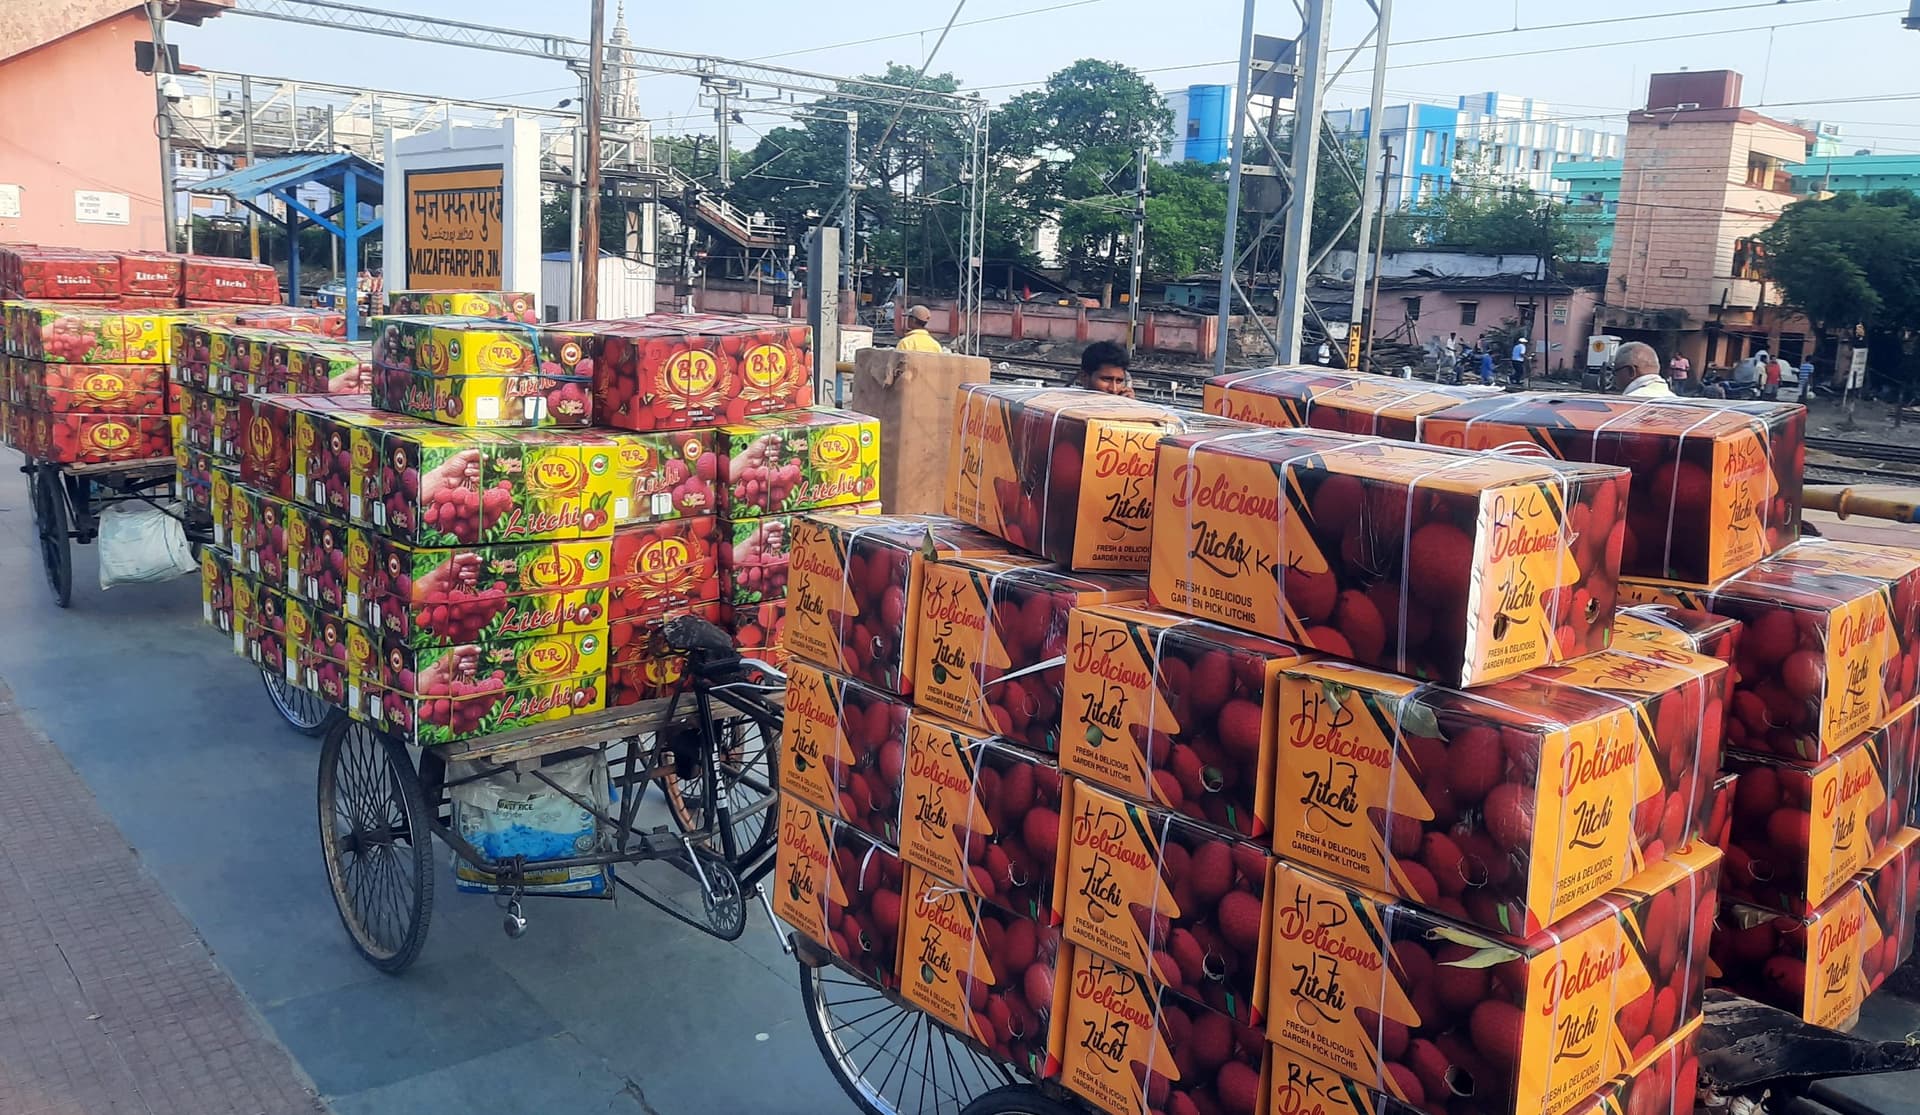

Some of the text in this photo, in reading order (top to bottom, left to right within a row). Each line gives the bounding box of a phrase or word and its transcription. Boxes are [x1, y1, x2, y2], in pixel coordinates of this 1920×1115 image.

[57, 274, 92, 285] Litchi
[136, 271, 169, 282] Litchi
[409, 247, 500, 277] MUZAFFARPUR JN.
[215, 278, 247, 288] Litchi
[492, 346, 518, 361] V.R.
[677, 359, 712, 381] B.R.
[751, 352, 782, 373] B.R.
[91, 379, 121, 393] B.R.
[99, 427, 127, 441] B.R.
[541, 463, 569, 478] V.R.
[634, 466, 680, 500] Litchi
[796, 472, 854, 505] Litchi
[1103, 493, 1152, 531] Litchi
[1172, 463, 1289, 522] Delicious
[503, 501, 580, 539] Litchi
[647, 547, 685, 570] B.R.
[792, 546, 843, 581] Delicious
[1188, 520, 1244, 578] Litchi
[1490, 525, 1559, 564] Delicious
[536, 562, 565, 576] V.R.
[796, 586, 824, 625] Litchi
[927, 592, 985, 631] Delicious
[1202, 585, 1208, 596] &
[1210, 587, 1253, 608] DELICIOUS
[1205, 600, 1223, 616] PICK
[1225, 606, 1256, 623] LITCHIS
[1493, 580, 1536, 625] Litchi
[497, 598, 576, 636] Litchi
[534, 649, 562, 661] V.R.
[931, 636, 965, 680] Litchi
[1073, 643, 1152, 690] Delicious
[1847, 656, 1868, 696] Litchi
[497, 684, 572, 725] Litchi
[787, 684, 838, 728] Delicious
[1080, 693, 1122, 742] Litchi
[791, 729, 819, 768] Litchi
[1075, 746, 1094, 759] FRESH
[1100, 754, 1128, 771] DELICIOUS
[1290, 713, 1391, 769] Delicious
[911, 750, 972, 794] Delicious
[1072, 755, 1131, 783] GARDEN PICK LITCHIS
[1558, 737, 1643, 798] Delicious
[915, 794, 948, 839] Litchi
[1300, 771, 1358, 827] Litchi
[1569, 795, 1613, 850] Litchi
[1831, 810, 1856, 853] Litchi
[784, 823, 829, 869] Delicious
[1073, 815, 1151, 870] Delicious
[1292, 840, 1370, 874] GARDEN PICK LITCHIS
[1295, 830, 1320, 845] FRESH
[1328, 840, 1367, 861] DELICIOUS
[788, 863, 814, 904] Litchi
[1576, 885, 1590, 898] PICK
[1591, 870, 1613, 889] LITCHIS
[1582, 856, 1613, 880] DELICIOUS
[1080, 867, 1122, 918] Litchi
[915, 891, 973, 942] Delicious
[1076, 917, 1094, 932] FRESH
[1100, 927, 1128, 948] DELICIOUS
[1072, 926, 1131, 959] GARDEN PICK LITCHIS
[1280, 906, 1383, 971] Delicious
[919, 935, 951, 983] Litchi
[1824, 954, 1851, 998] Litchi
[1290, 962, 1346, 1023] Litchi
[1542, 942, 1630, 1016] Delicious
[1076, 969, 1153, 1031] Delicious
[1081, 1019, 1125, 1073] Litchi
[1282, 1029, 1358, 1071] GARDEN PICK LITCHIS
[1286, 1020, 1354, 1058] FRESH & DELICIOUS
[1554, 1005, 1599, 1064] Litchi
[1072, 1076, 1095, 1094] GARDEN
[1095, 1087, 1108, 1103] PICK
[1075, 1068, 1094, 1083] FRESH
[1099, 1081, 1128, 1104] DELICIOUS
[1569, 1060, 1600, 1088] DELICIOUS
